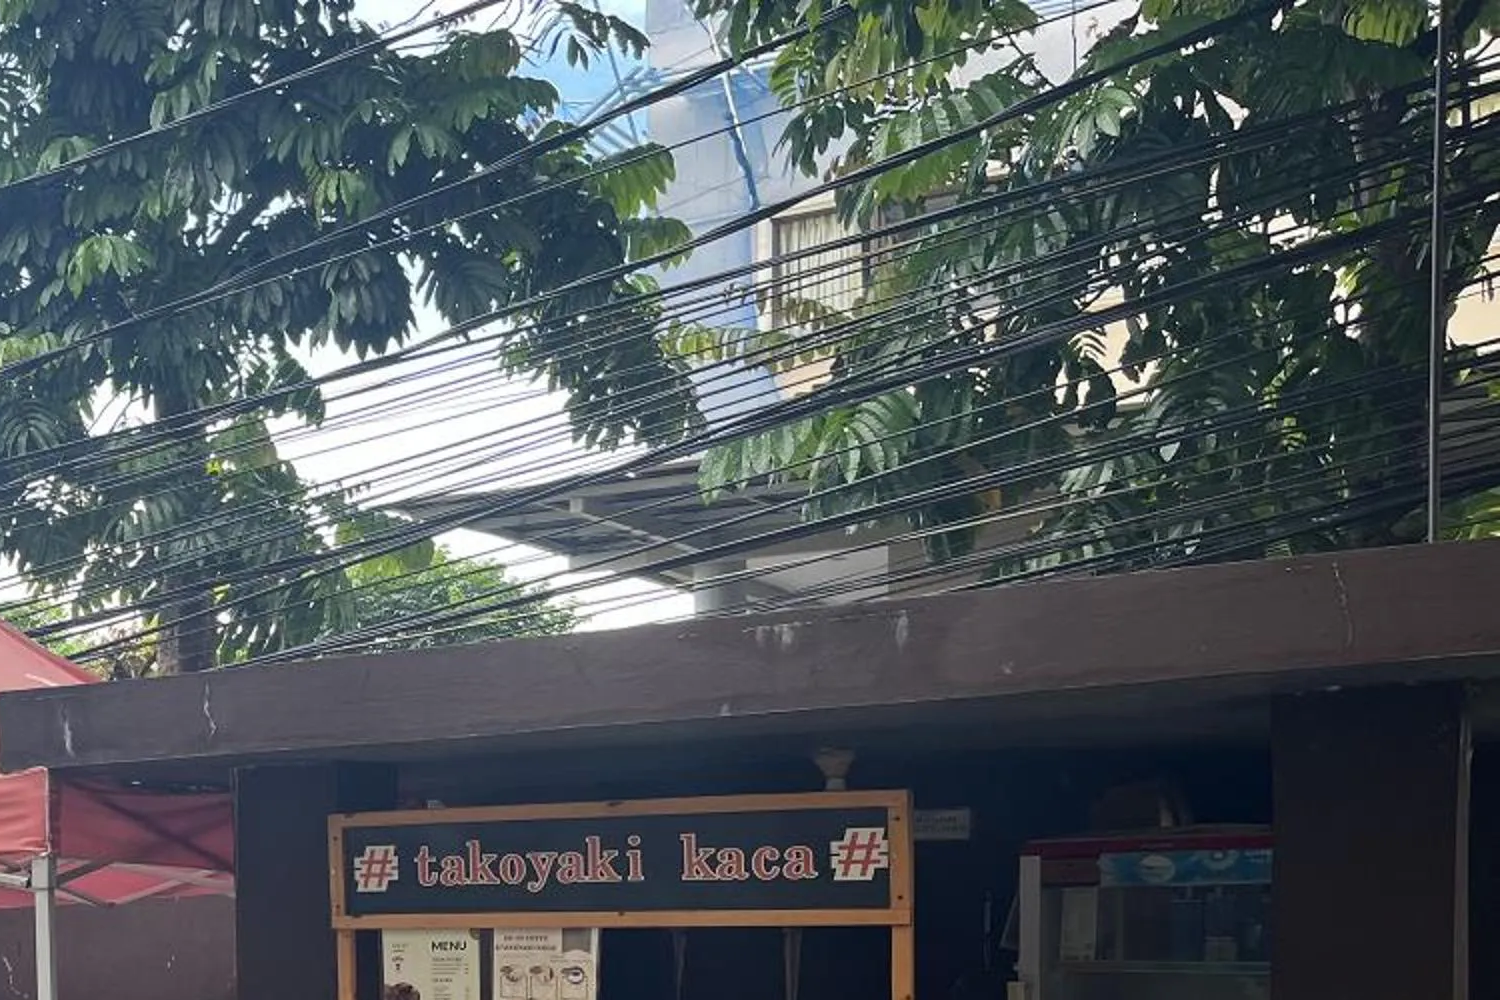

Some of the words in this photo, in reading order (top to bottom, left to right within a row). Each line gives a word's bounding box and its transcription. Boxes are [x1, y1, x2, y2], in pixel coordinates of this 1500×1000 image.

[414, 835, 645, 892] takoyaki
[680, 832, 818, 881] kaca
[431, 941, 467, 953] MENU
